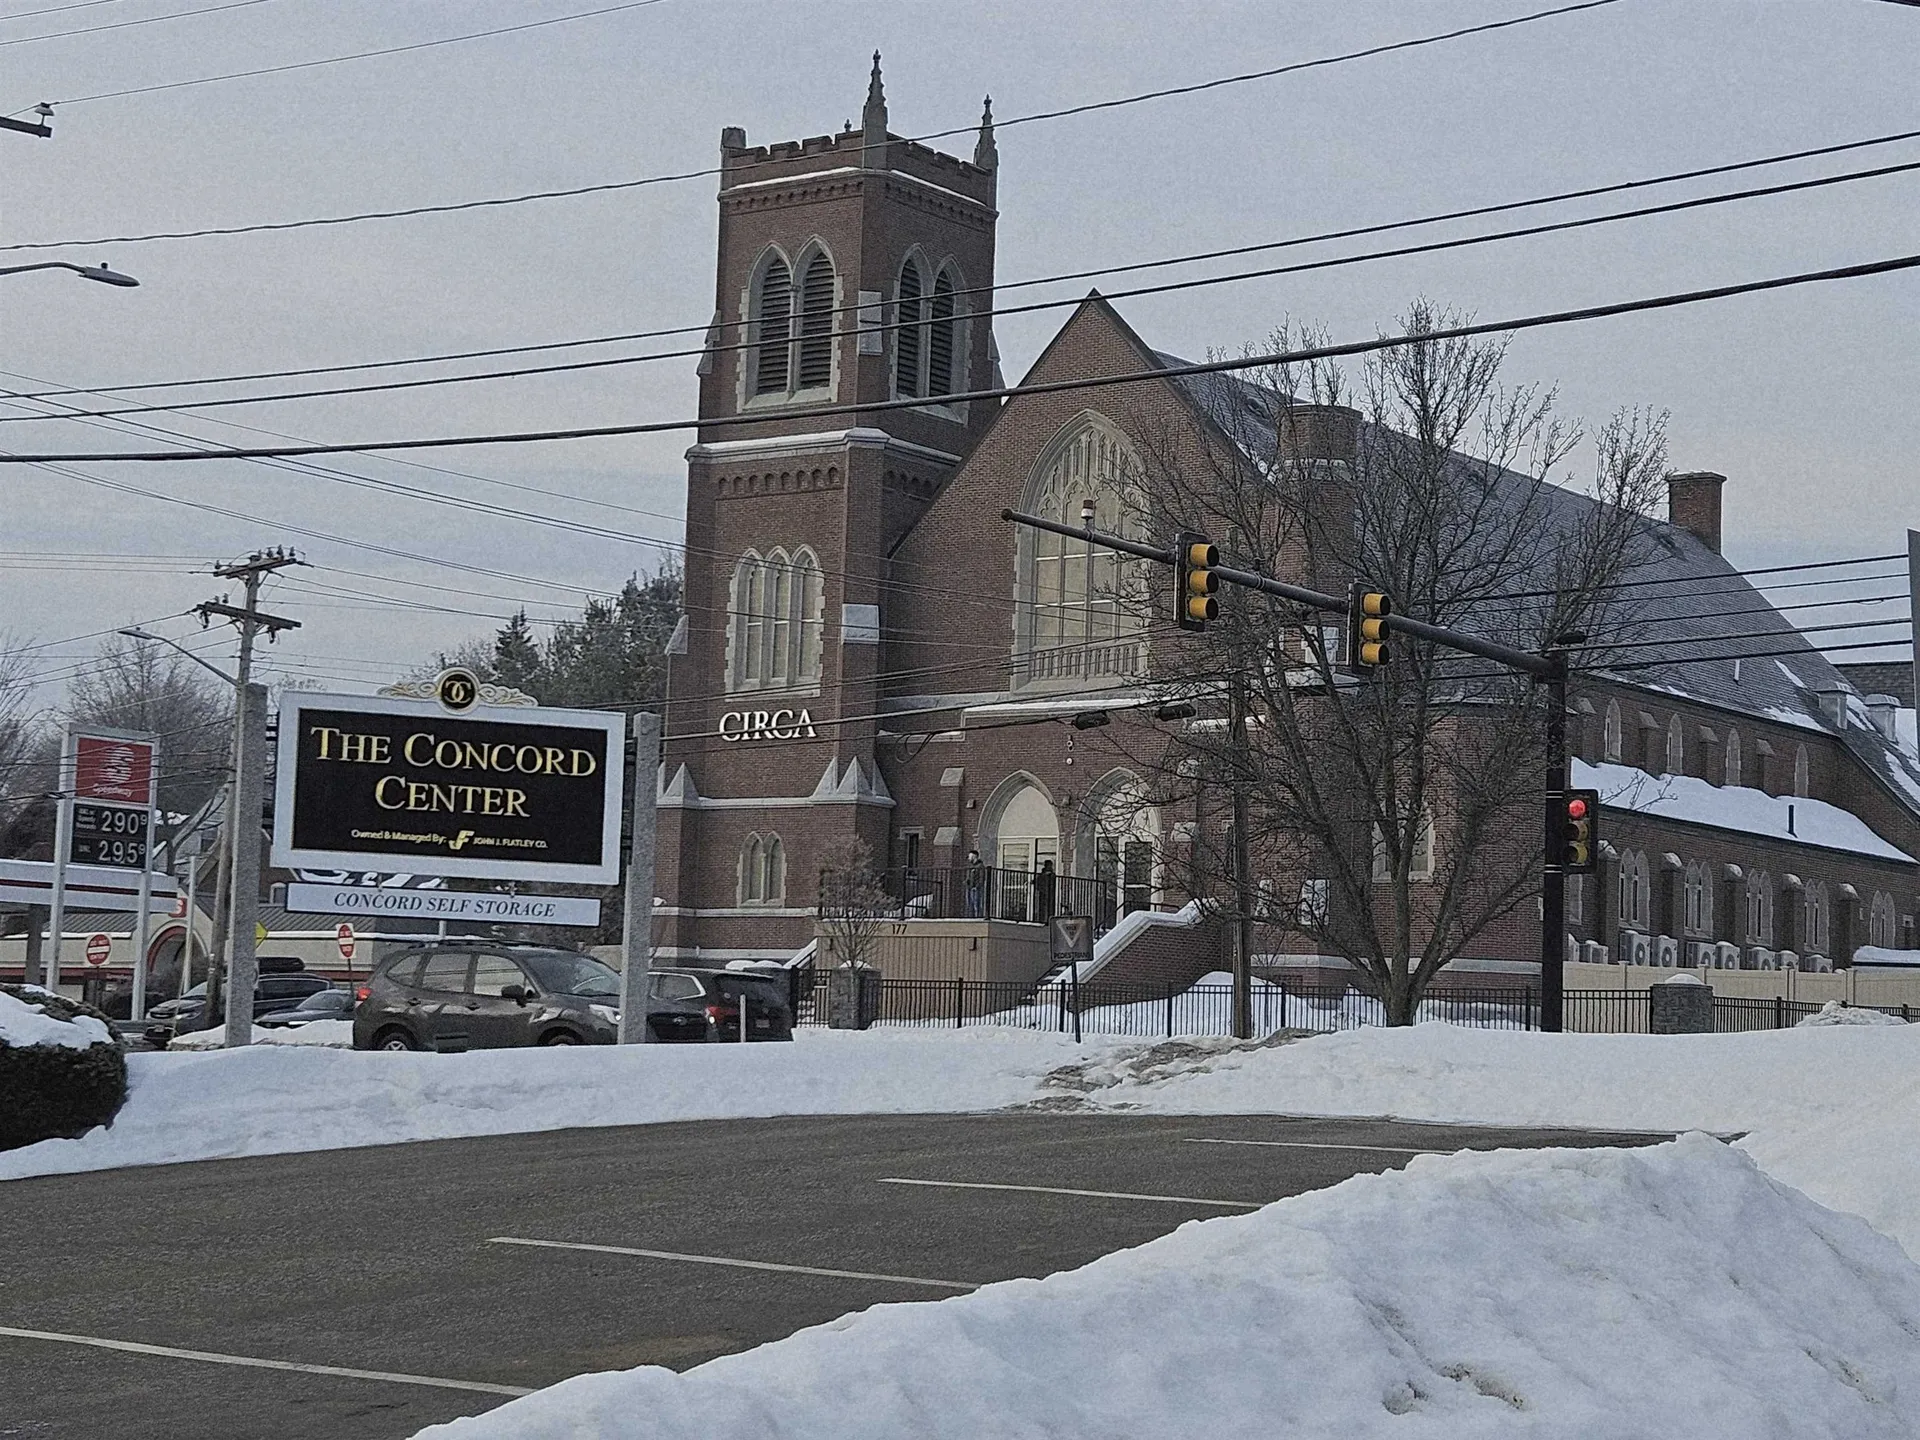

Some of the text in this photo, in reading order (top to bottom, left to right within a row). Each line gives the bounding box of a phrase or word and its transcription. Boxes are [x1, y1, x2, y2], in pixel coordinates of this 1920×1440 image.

[719, 708, 817, 742] CIRCA
[310, 727, 597, 777] THE CONCORD
[375, 776, 530, 818] CENTER
[351, 829, 383, 840] Owned
[384, 831, 391, 840] &
[392, 832, 432, 844] Managed
[473, 837, 495, 846] JOHN
[502, 839, 534, 848] FLATLEY
[334, 892, 556, 917] CONCORD SELF STORAGE
[892, 923, 908, 935] 177
